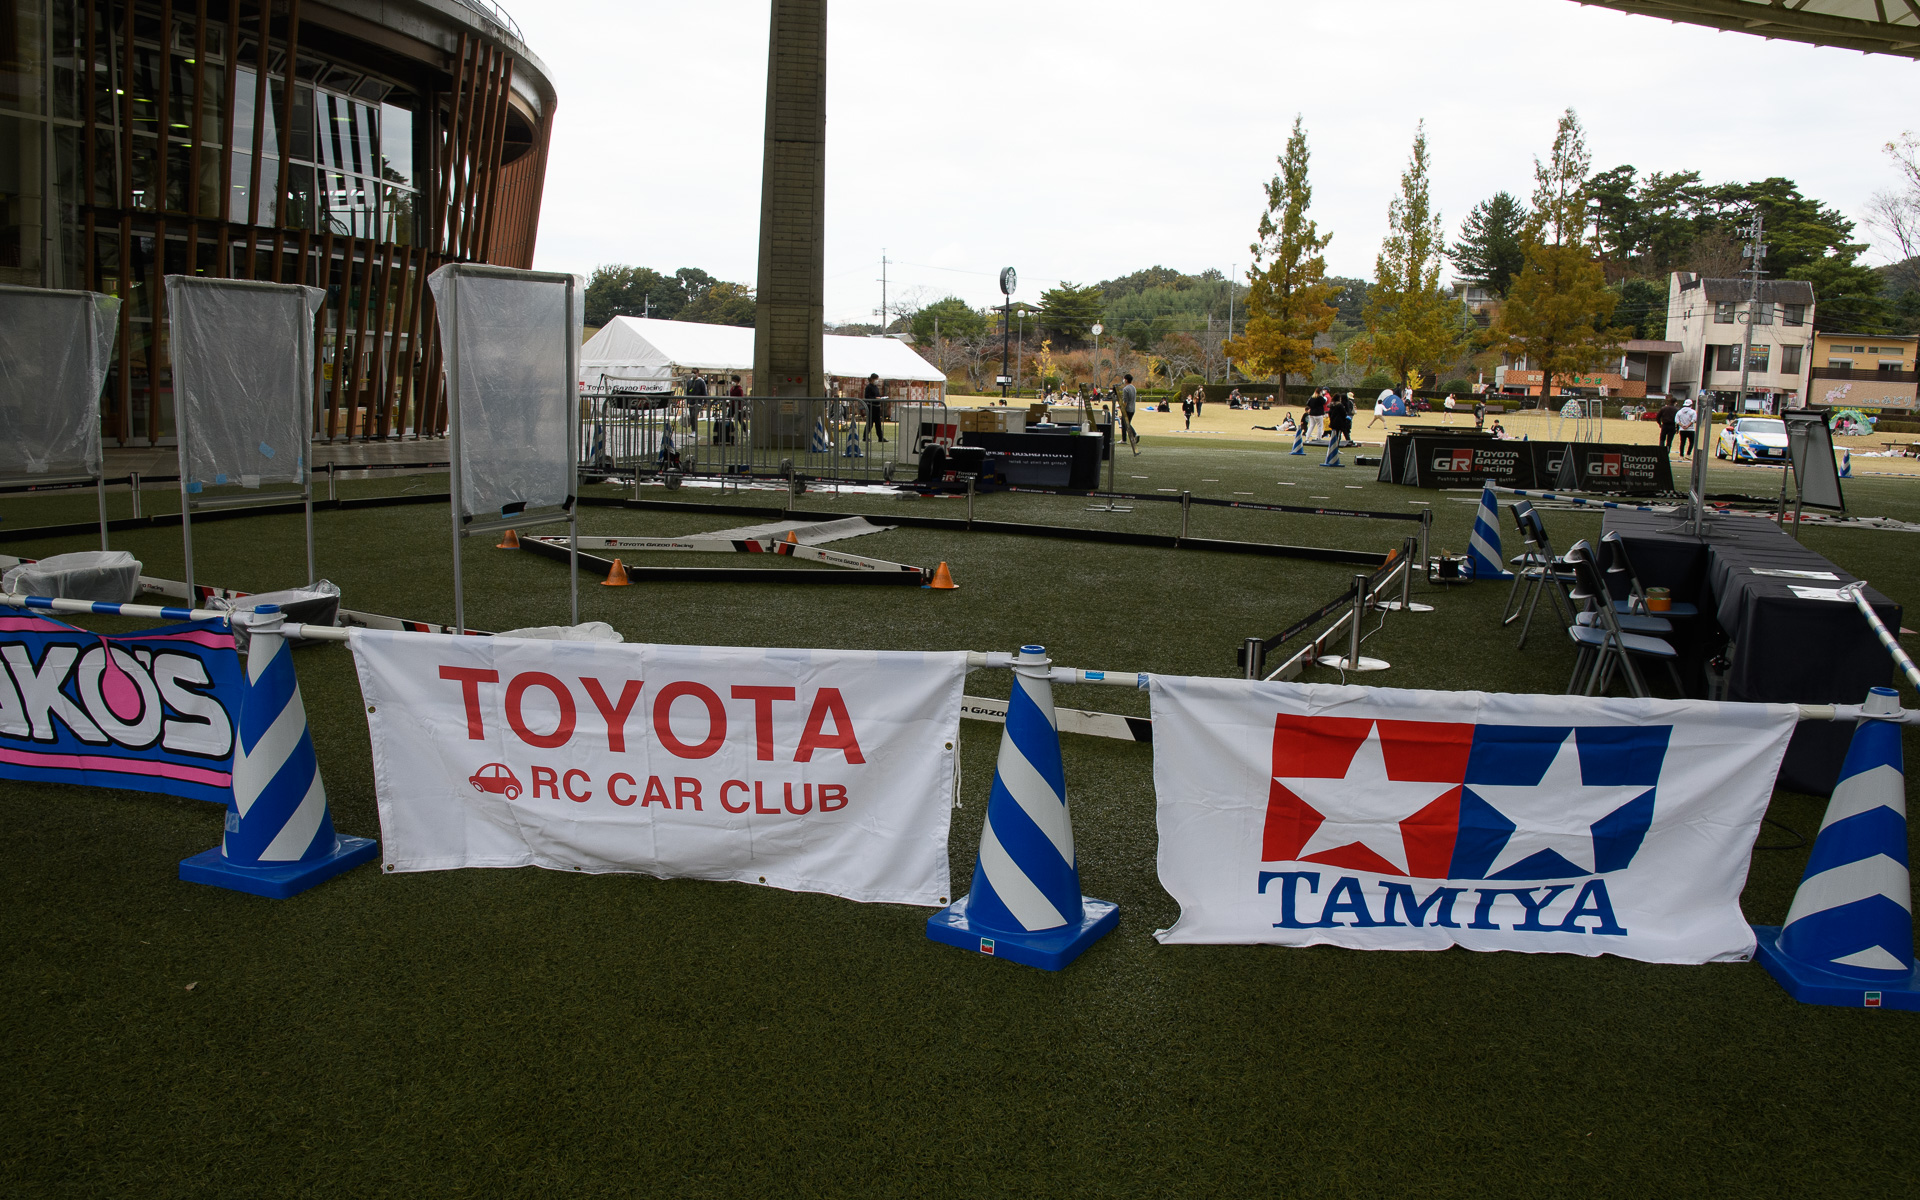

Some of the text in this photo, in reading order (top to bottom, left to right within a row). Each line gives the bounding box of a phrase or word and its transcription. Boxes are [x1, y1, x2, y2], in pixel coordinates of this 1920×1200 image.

[640, 384, 669, 392] Racing
[1881, 395, 1912, 406] みどり
[1475, 449, 1519, 458] TOYOTA
[1622, 454, 1659, 463] TOYOTA
[1433, 457, 1470, 471] GR
[1474, 457, 1515, 465] GAZOO
[1622, 462, 1655, 470] GAZOO
[1474, 465, 1514, 475] Racing
[1588, 461, 1619, 475] GR
[1623, 469, 1655, 479] Racing
[438, 664, 866, 765] TOYOTA
[530, 765, 850, 815] RC CAR CLUB
[1257, 870, 1629, 937] TAMIYA
